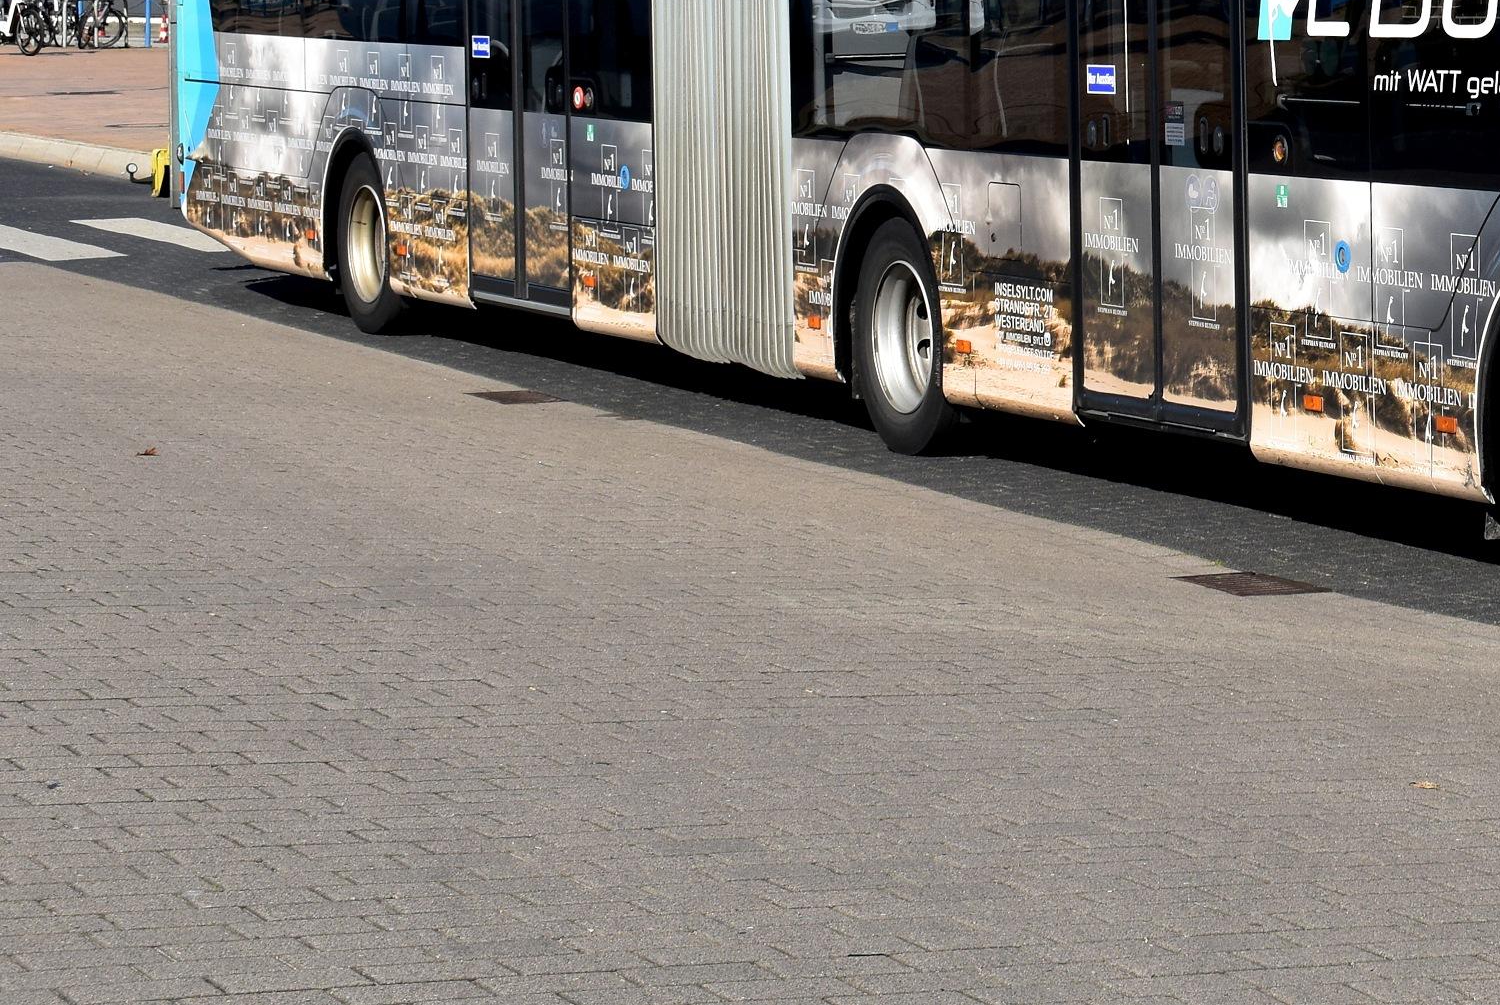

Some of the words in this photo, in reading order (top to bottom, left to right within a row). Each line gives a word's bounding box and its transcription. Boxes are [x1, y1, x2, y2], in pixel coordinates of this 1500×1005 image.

[1374, 70, 1402, 92] mit
[1407, 68, 1462, 94] WATT
[1084, 232, 1139, 253] IMMOBILIEN
[1174, 243, 1232, 265] IMMOBILIEN
[1357, 265, 1424, 289] IMMOBILIEN
[1430, 273, 1496, 298] IMMOBILIEN
[994, 282, 1054, 303] INSELSYLT.COM
[995, 297, 1043, 318] STRANDSTR.
[994, 313, 1045, 334] WESTERLAND
[1274, 335, 1292, 359] Nº1
[1344, 344, 1364, 369] Nº1
[1253, 359, 1314, 383] IMMOBILIEN
[1418, 355, 1438, 380] Nº1
[1322, 369, 1387, 395] IMMOBILIEN
[1395, 379, 1463, 407] IMMOBILIEN
